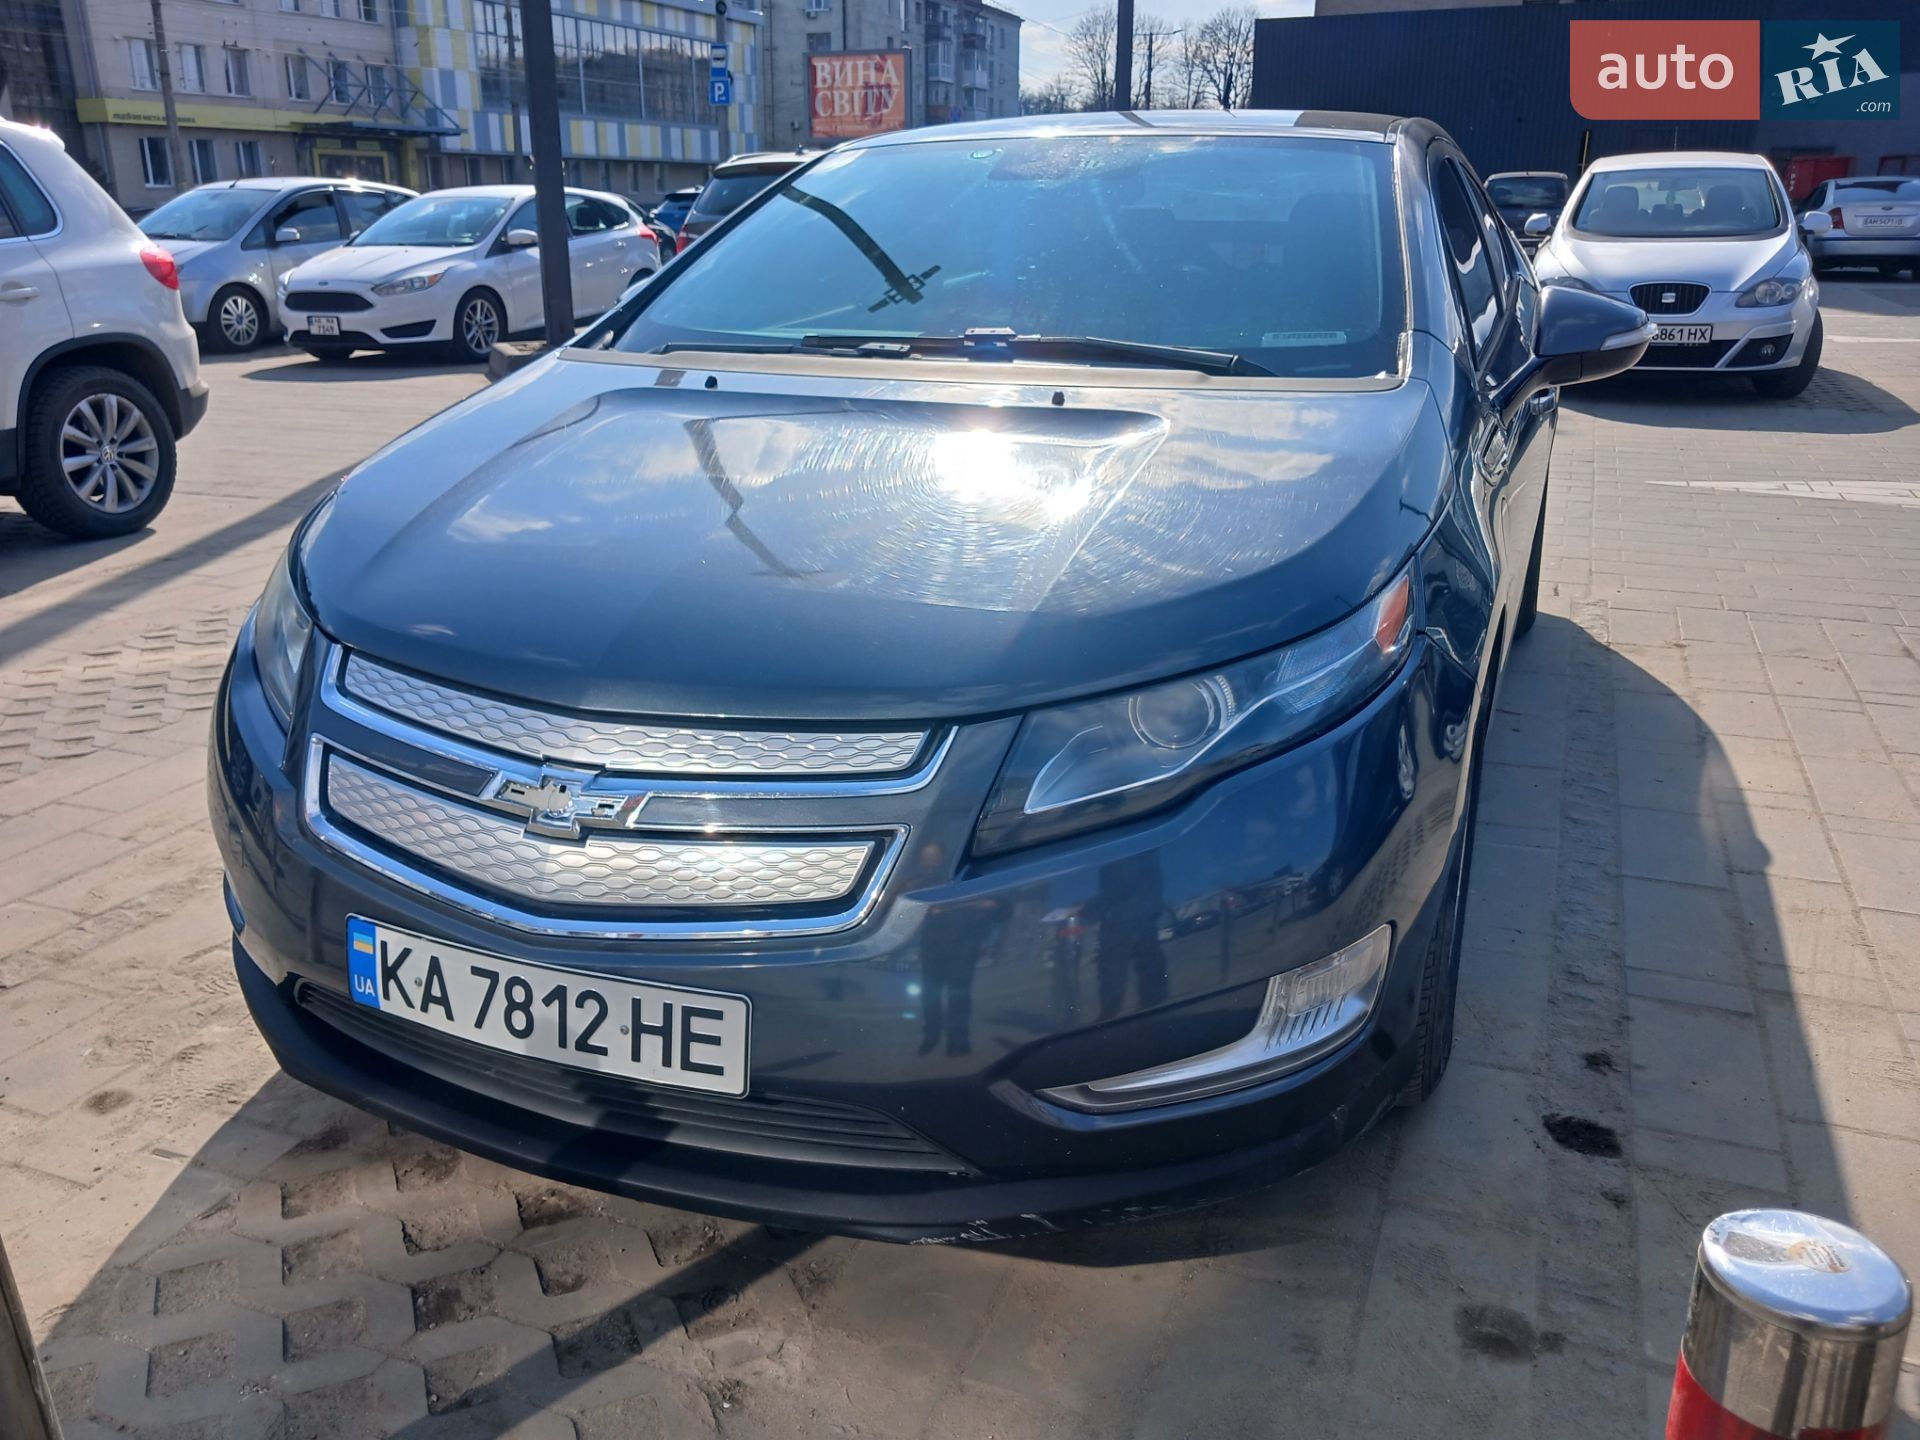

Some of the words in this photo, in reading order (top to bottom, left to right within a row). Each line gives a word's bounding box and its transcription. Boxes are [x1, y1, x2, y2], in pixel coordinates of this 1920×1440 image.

[815, 58, 900, 88] ВИНА
[815, 87, 899, 118] СВІТУ
[1687, 328, 1709, 341] HX
[354, 973, 377, 998] UA
[380, 940, 455, 1022] KA
[470, 965, 609, 1057] 7812
[631, 996, 725, 1077] HE
